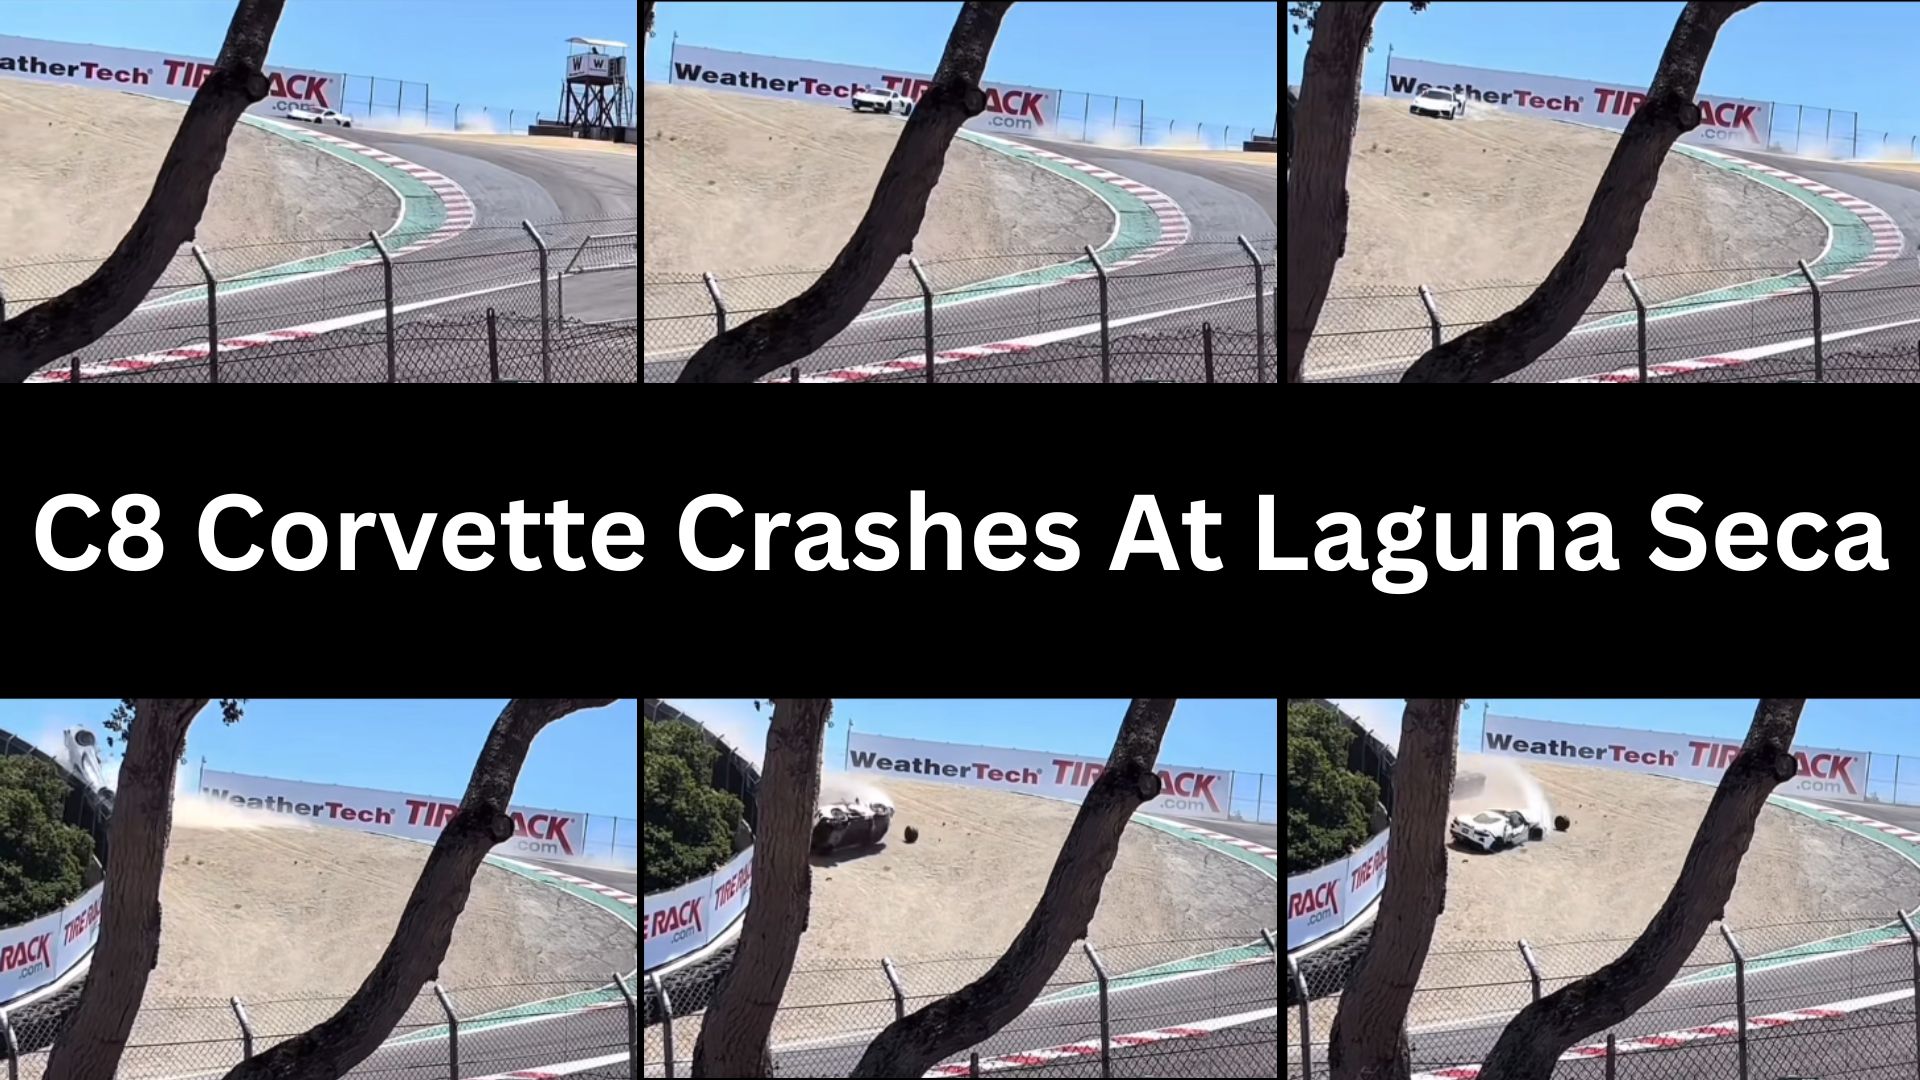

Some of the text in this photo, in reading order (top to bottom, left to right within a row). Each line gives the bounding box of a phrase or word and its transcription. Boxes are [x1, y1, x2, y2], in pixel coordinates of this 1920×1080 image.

[0, 56, 328, 108] atherTech TIR ACK
[882, 75, 934, 103] TIR
[986, 88, 1044, 126] ACK
[988, 115, 1032, 129] .com
[1594, 88, 1648, 115] TIR
[1700, 100, 1760, 144] ACK
[850, 750, 1220, 812] WeatherTech TIR ACK
[1486, 732, 1857, 794] WeatherTech TIR ACK
[1796, 780, 1841, 793] .com
[406, 799, 460, 827] TIR
[513, 812, 573, 855] ACK
[1160, 799, 1205, 811] .com
[651, 896, 703, 938] RACK
[1288, 879, 1339, 919] RACK
